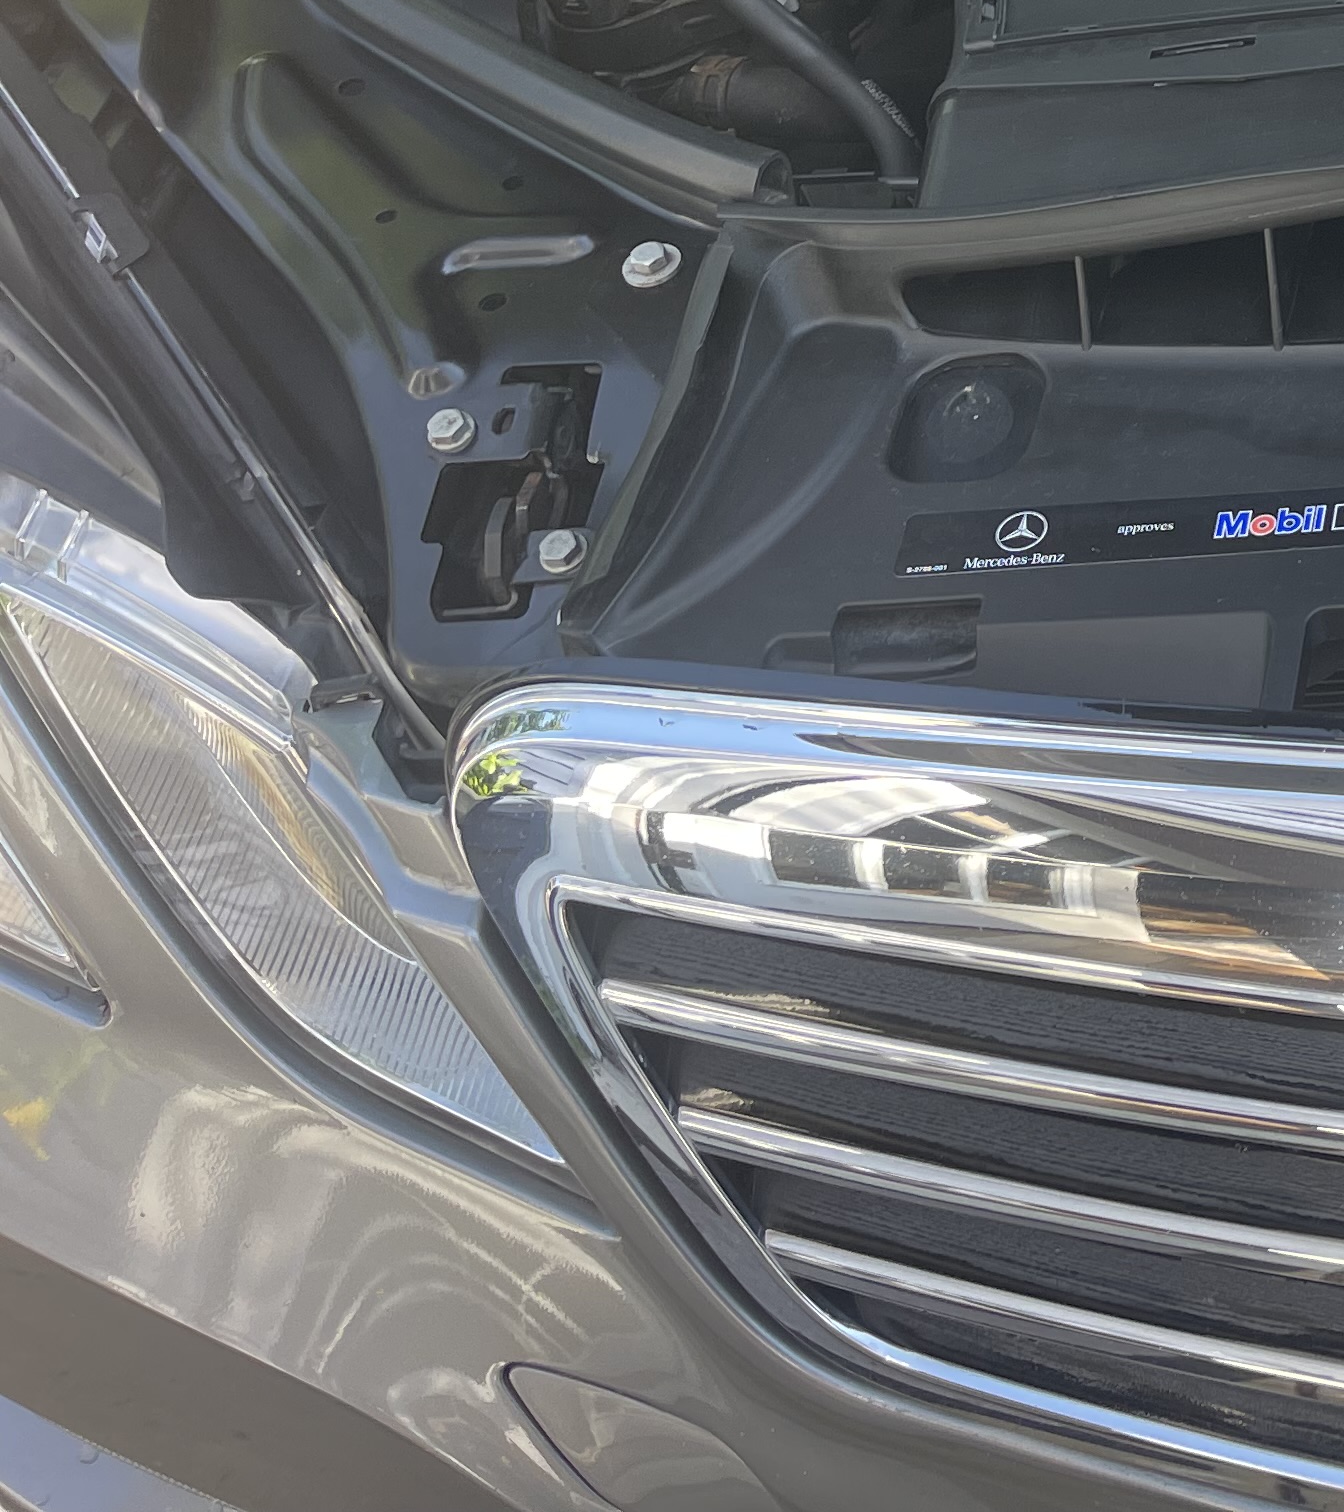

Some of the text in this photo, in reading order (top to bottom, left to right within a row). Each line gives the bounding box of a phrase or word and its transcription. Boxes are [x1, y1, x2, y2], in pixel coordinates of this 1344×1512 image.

[1117, 520, 1174, 535] approves
[1213, 505, 1327, 539] Mobil
[962, 552, 1065, 570] Mercedes-Benz
